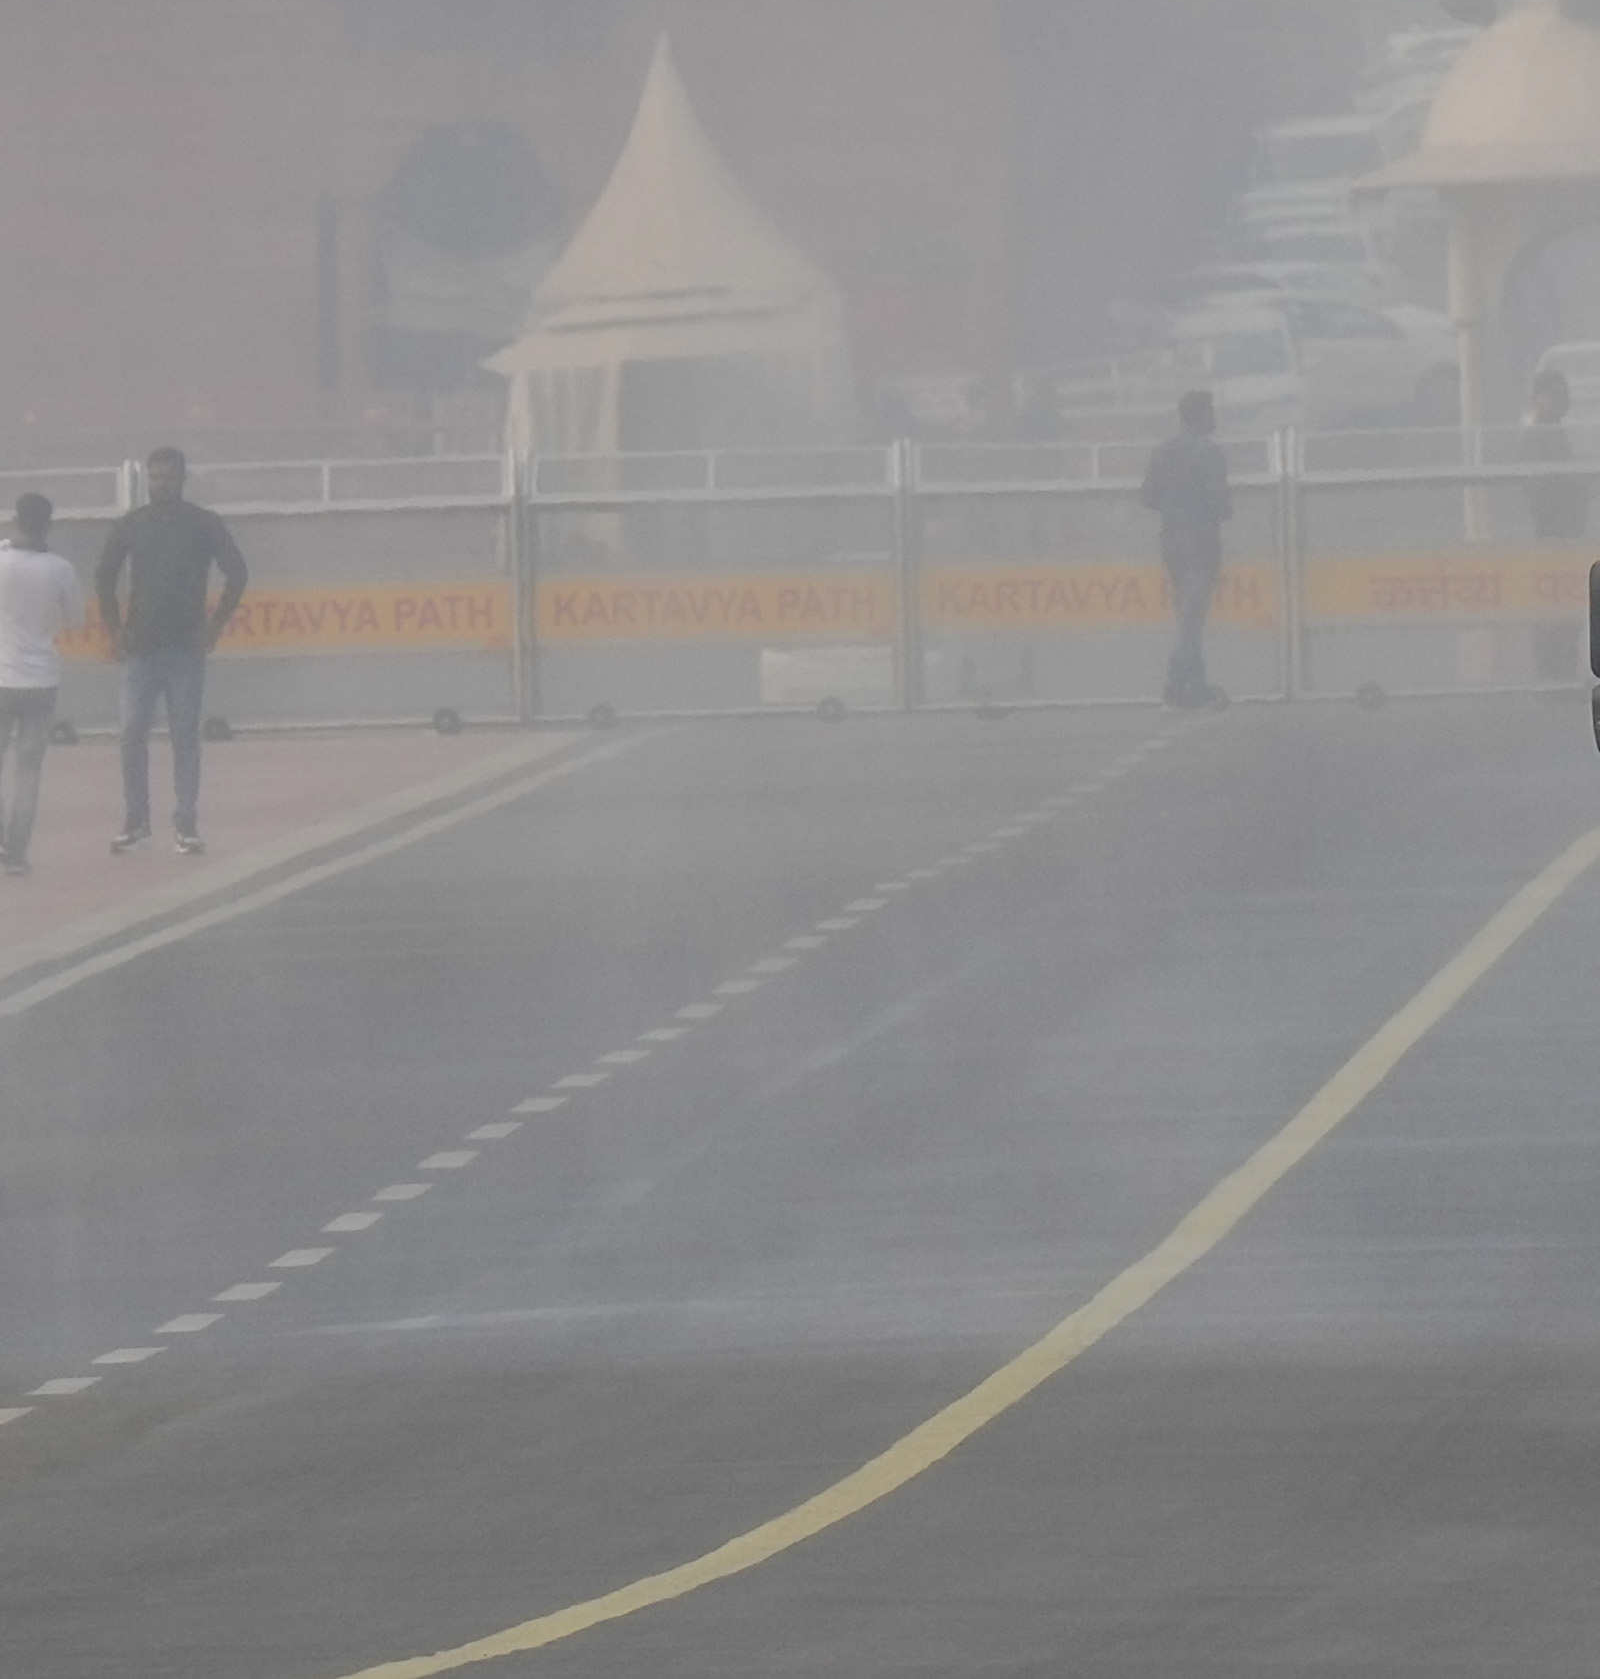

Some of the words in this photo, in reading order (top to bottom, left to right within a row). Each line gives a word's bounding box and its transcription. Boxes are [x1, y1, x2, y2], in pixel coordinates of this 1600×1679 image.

[227, 595, 379, 637] RTAVYA
[394, 594, 495, 633] PATH
[552, 589, 763, 627] KARTAVYA
[777, 586, 877, 623] PATH
[938, 577, 1148, 615] KARTAVYA
